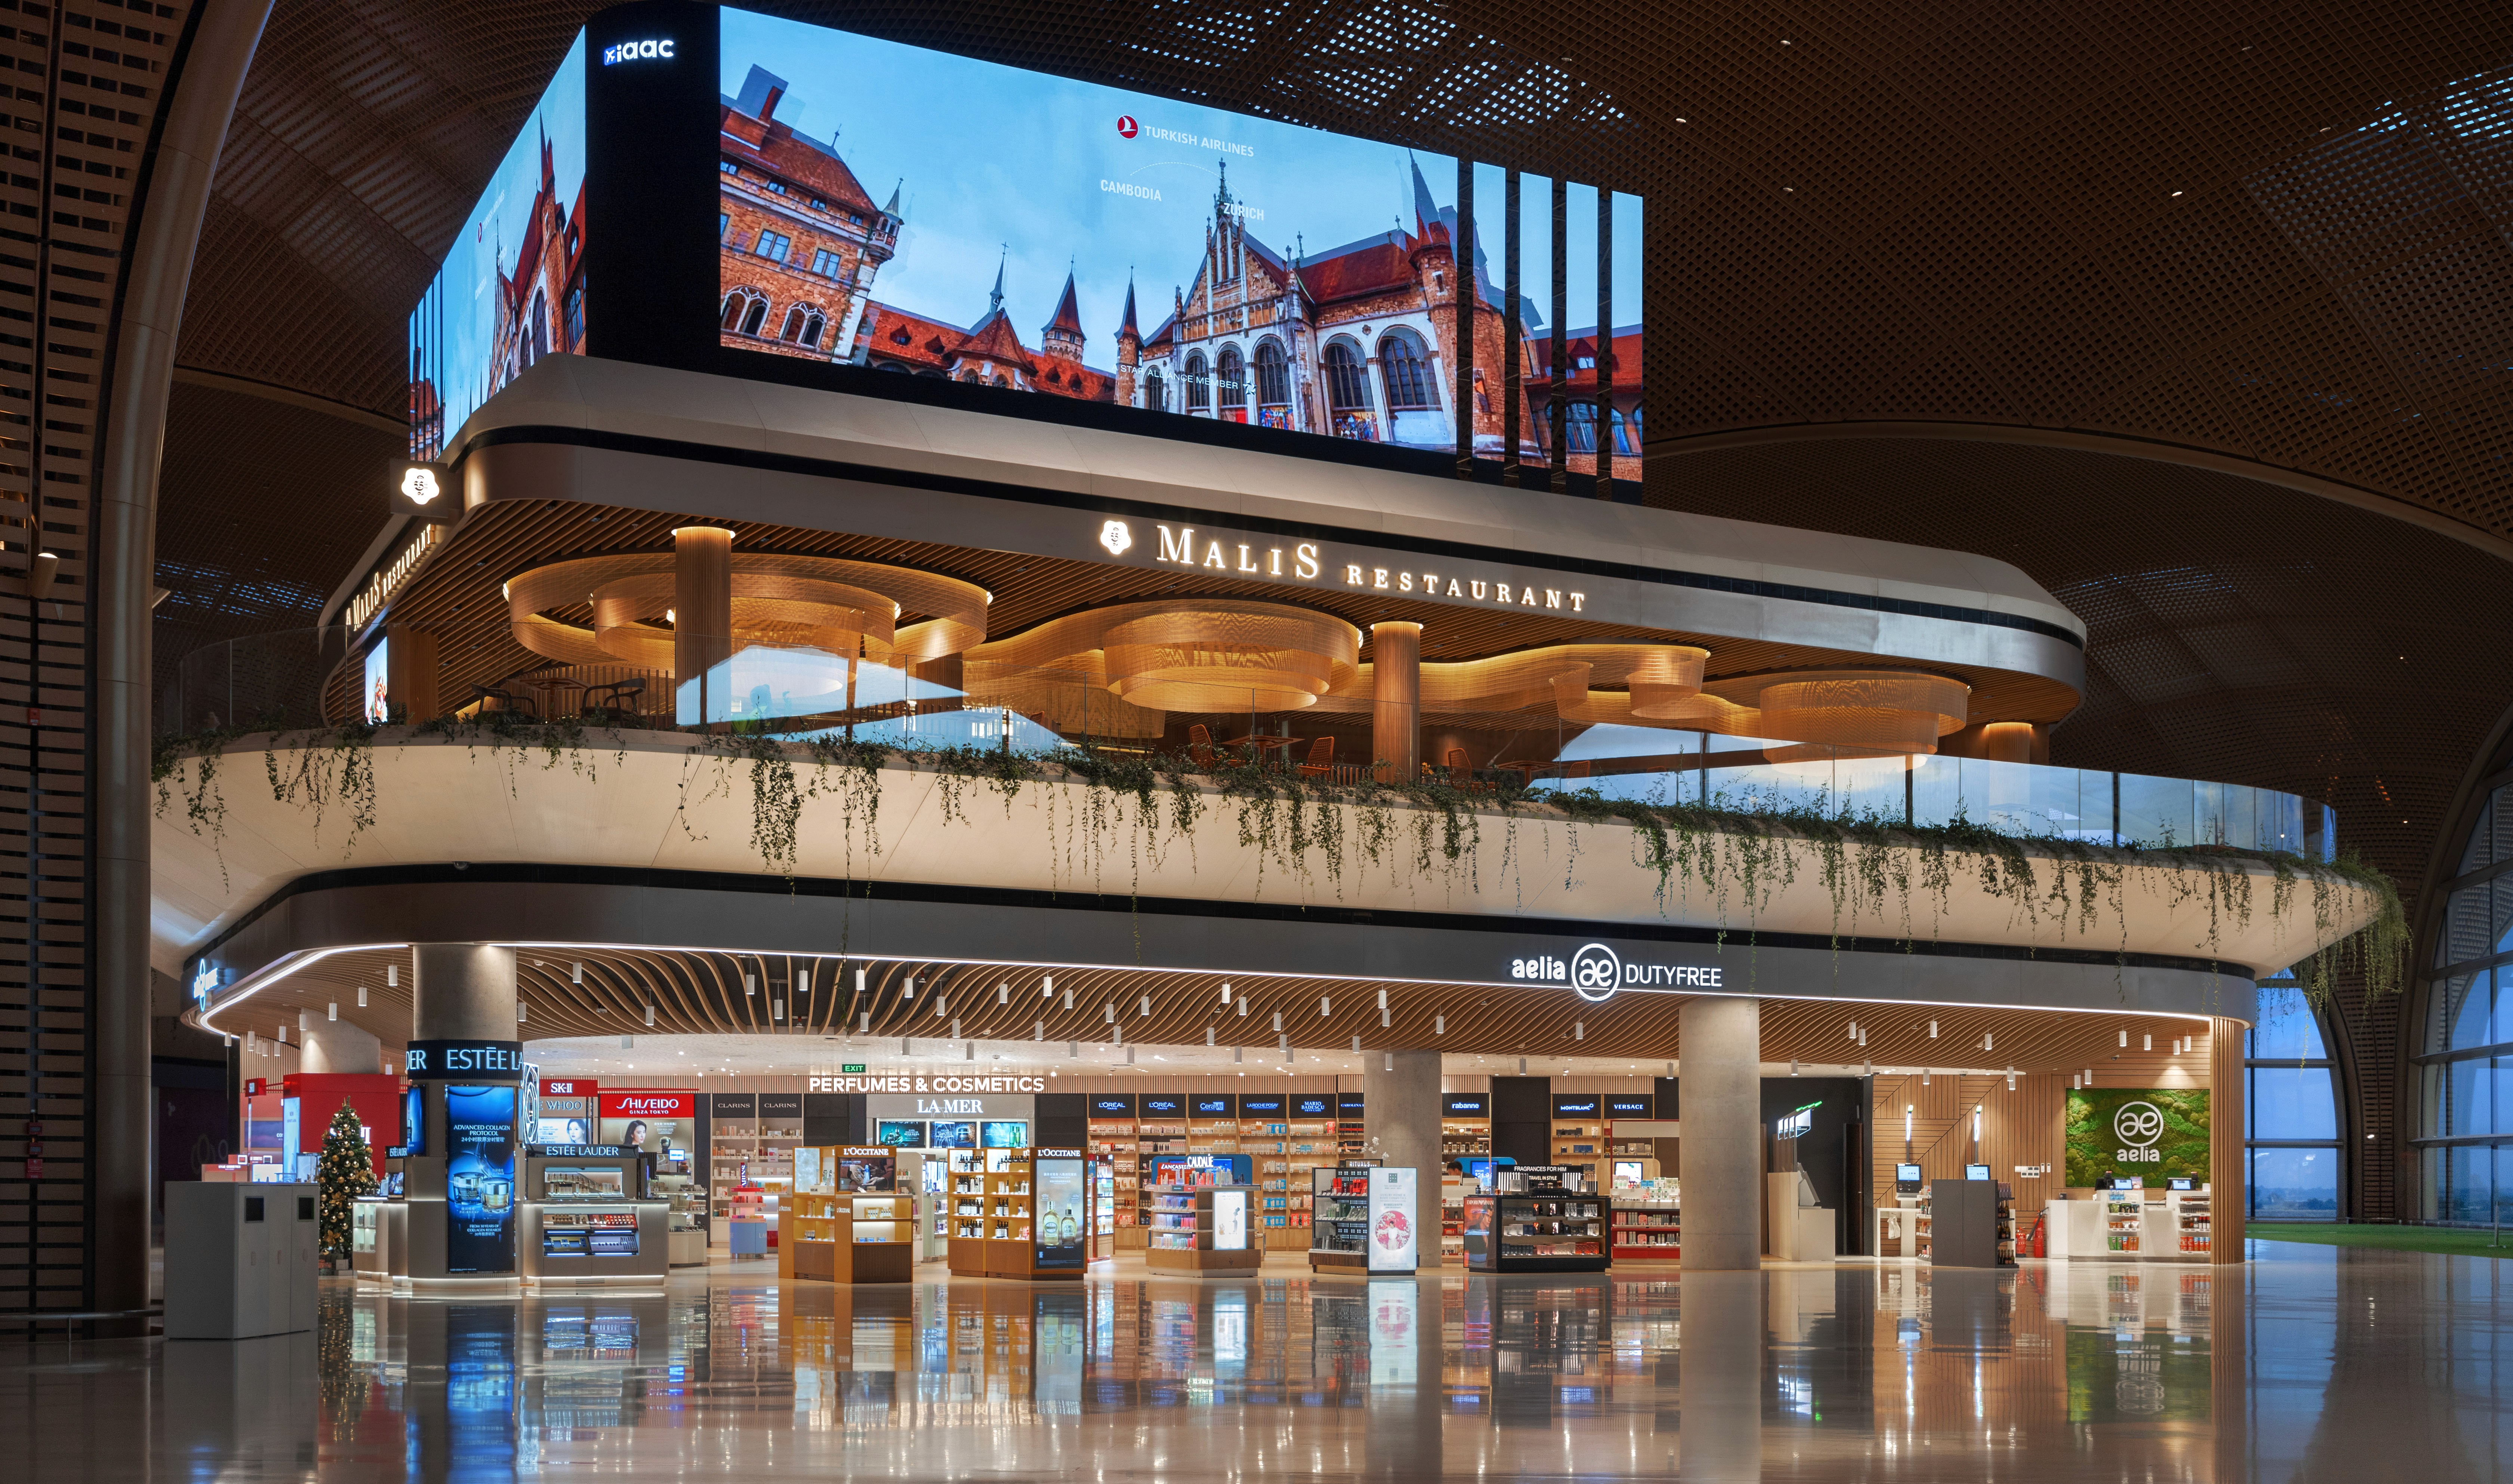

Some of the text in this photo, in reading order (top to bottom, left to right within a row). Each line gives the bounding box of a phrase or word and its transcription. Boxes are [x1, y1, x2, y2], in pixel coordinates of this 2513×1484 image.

[616, 40, 674, 62] iaac
[1145, 126, 1254, 157] TURKISH AIRLINES
[1100, 179, 1162, 201] CAMBODIA
[1223, 202, 1265, 221] ZURICH
[1121, 365, 1144, 375] STAR
[1148, 369, 1193, 383] ALLIANCE
[1196, 376, 1238, 390] MEMBER
[384, 524, 432, 596] RESTAURANT
[1157, 525, 1584, 612] MALIS RESTAURANT
[1512, 956, 1566, 980] aelia
[1626, 964, 1722, 987] DUTYFREE
[551, 1083, 573, 1093] SK-II
[810, 1077, 1044, 1092] PERFUMES & COSMETICS
[546, 1101, 582, 1111] WHOO
[616, 1097, 679, 1109] SHISEIDO
[917, 1100, 983, 1113] LA MER
[397, 1148, 407, 1156] LAUDER
[579, 1147, 619, 1155] LAUDER
[844, 1147, 889, 1156] L'OCCITANE
[1038, 1149, 1081, 1157] L'OCCITANE
[2117, 1146, 2160, 1162] aelia
